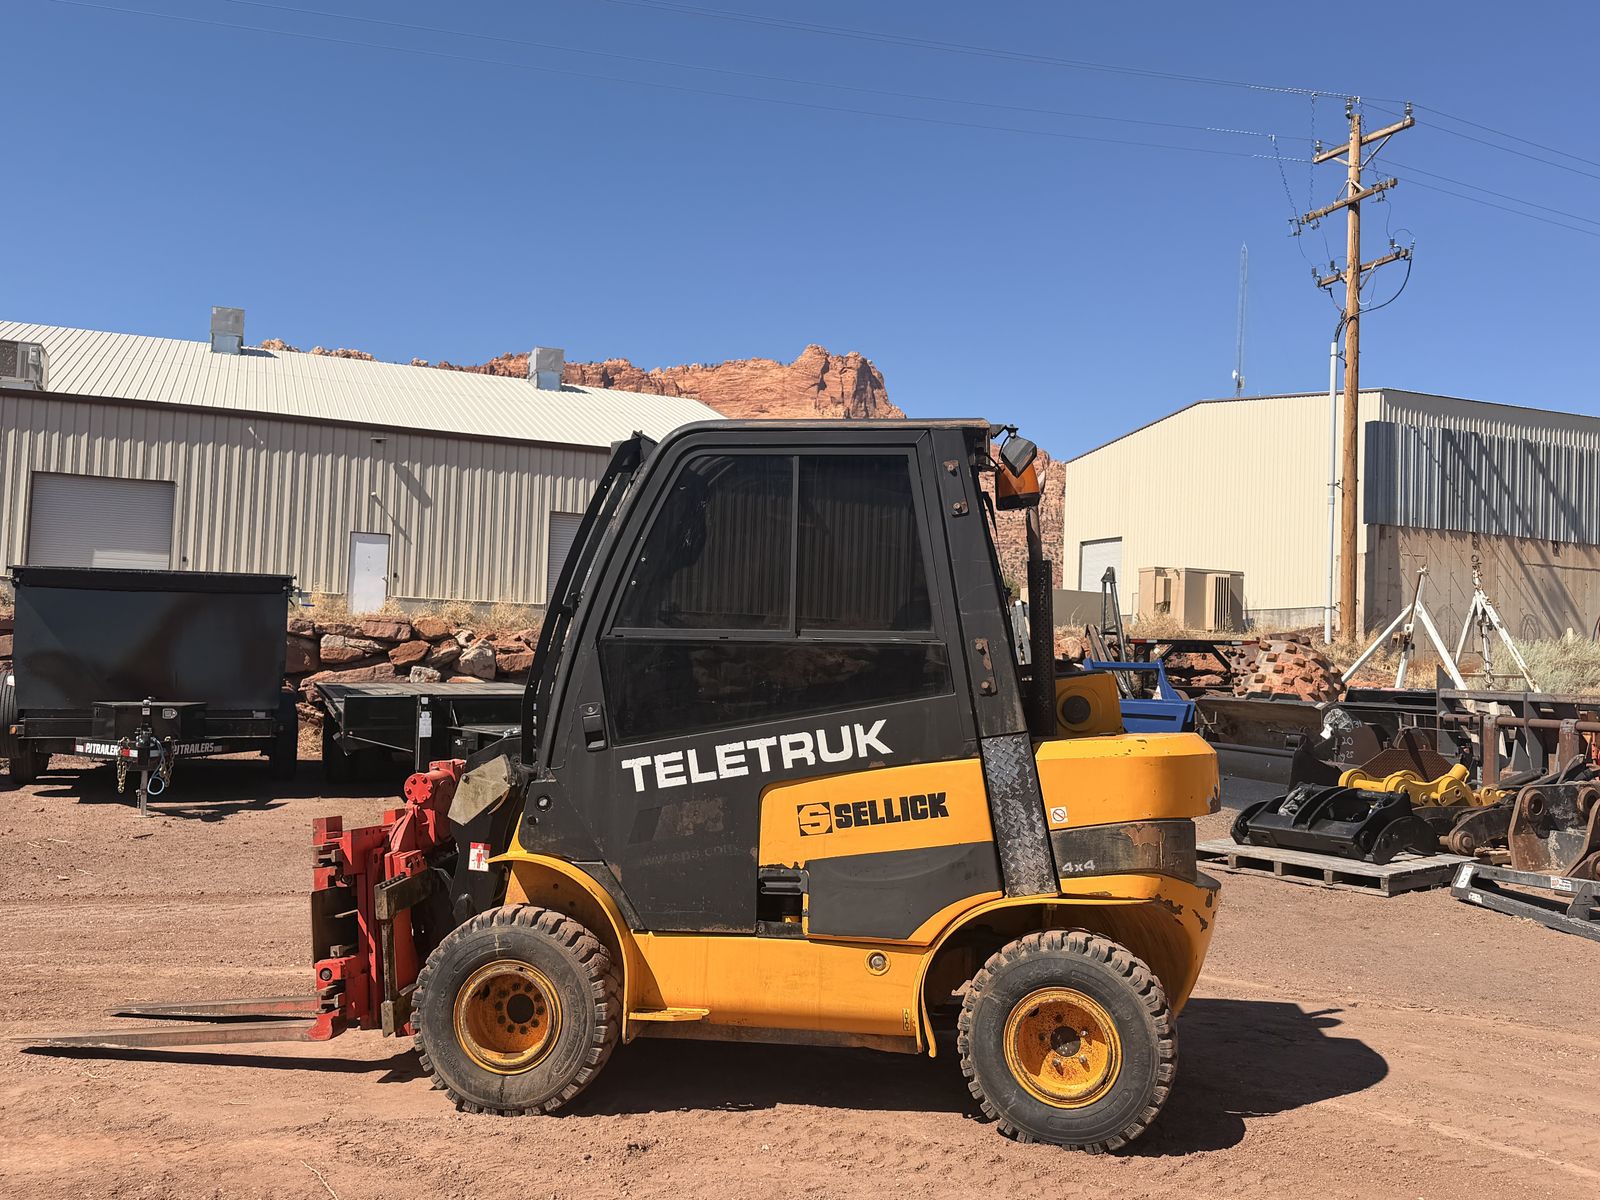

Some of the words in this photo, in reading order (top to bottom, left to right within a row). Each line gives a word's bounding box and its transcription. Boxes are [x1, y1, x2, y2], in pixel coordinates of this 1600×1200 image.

[621, 719, 894, 792] TELETRUK
[834, 792, 950, 829] SELLICK
[1062, 859, 1096, 873] 4x4
